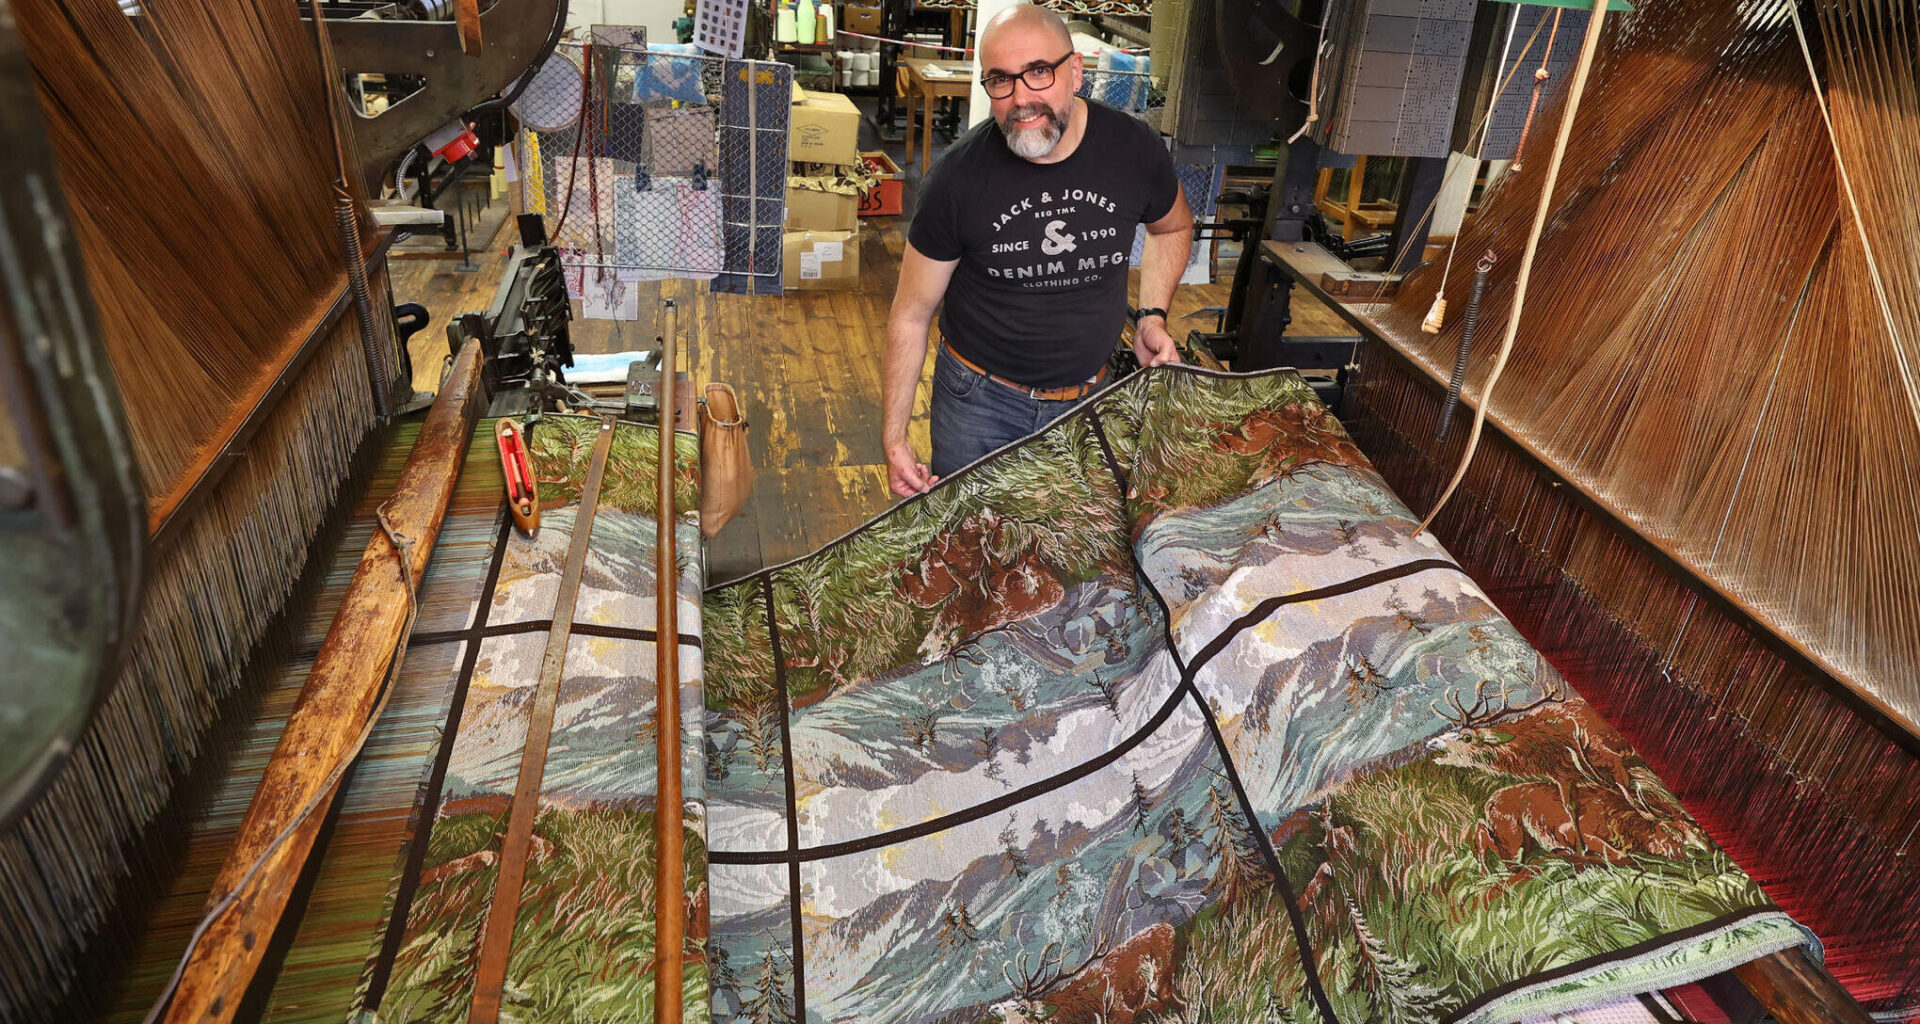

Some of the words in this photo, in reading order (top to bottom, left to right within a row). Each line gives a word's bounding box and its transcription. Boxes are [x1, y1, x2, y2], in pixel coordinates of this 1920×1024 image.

[992, 197, 1033, 231] JACK
[1041, 191, 1053, 203] &
[1062, 189, 1117, 213] JONES
[1034, 210, 1053, 219] REG
[1056, 206, 1076, 215] TMK
[991, 240, 1030, 253] SINCE
[1041, 220, 1077, 256] &
[1081, 227, 1117, 241] 1990
[988, 261, 1065, 279] DENIM
[1078, 251, 1129, 271] MFG.
[1023, 277, 1080, 288] CLOTHING
[1084, 274, 1102, 284] CO.
